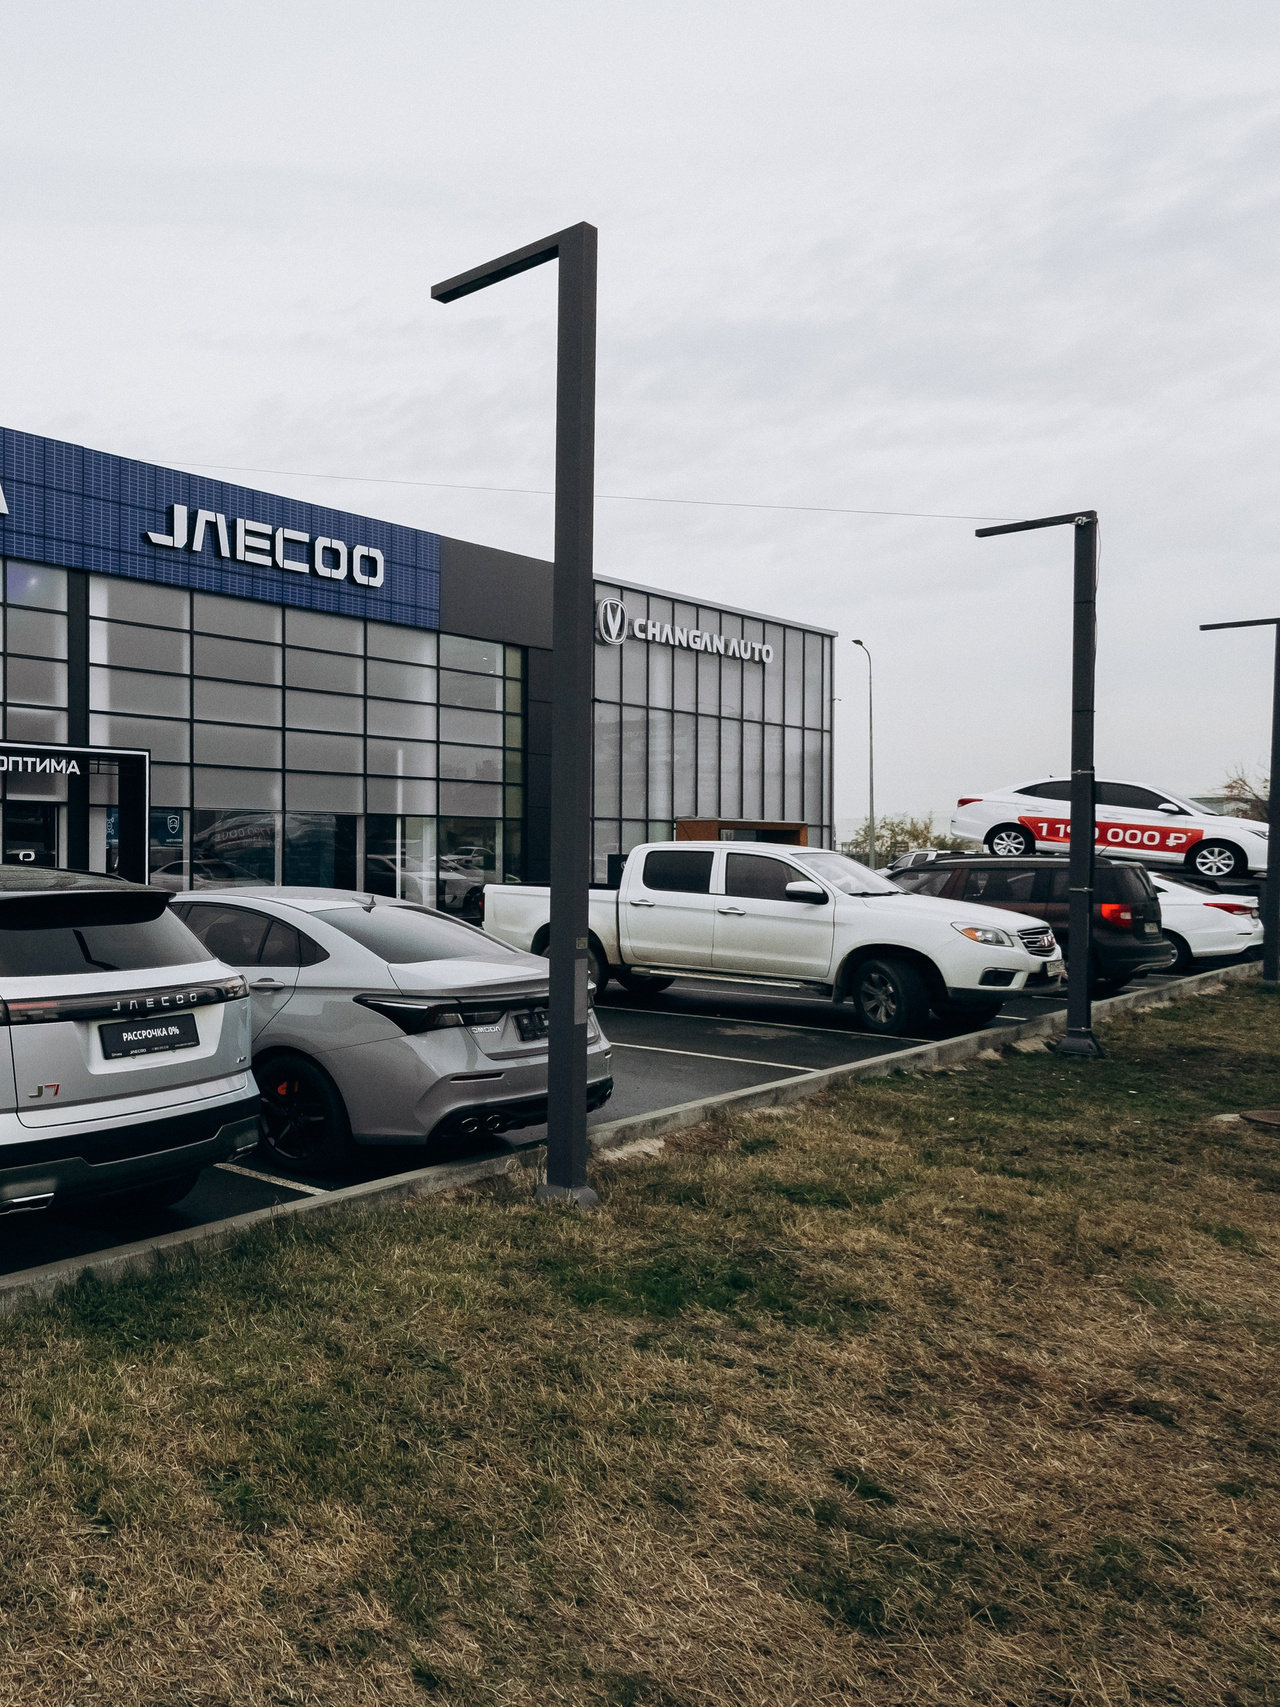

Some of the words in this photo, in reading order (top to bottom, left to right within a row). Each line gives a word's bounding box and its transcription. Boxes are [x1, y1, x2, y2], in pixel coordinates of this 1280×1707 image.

[146, 503, 384, 588] JAECOO
[633, 618, 725, 655] CHANGAN
[728, 638, 774, 664] AUTO
[1106, 828, 1161, 845] 000
[111, 992, 198, 1012] JAECOO
[122, 1027, 169, 1042] РАССРОЧКА
[168, 1025, 180, 1036] 0%
[471, 1026, 501, 1034] OMODA
[28, 1083, 60, 1098] J7
